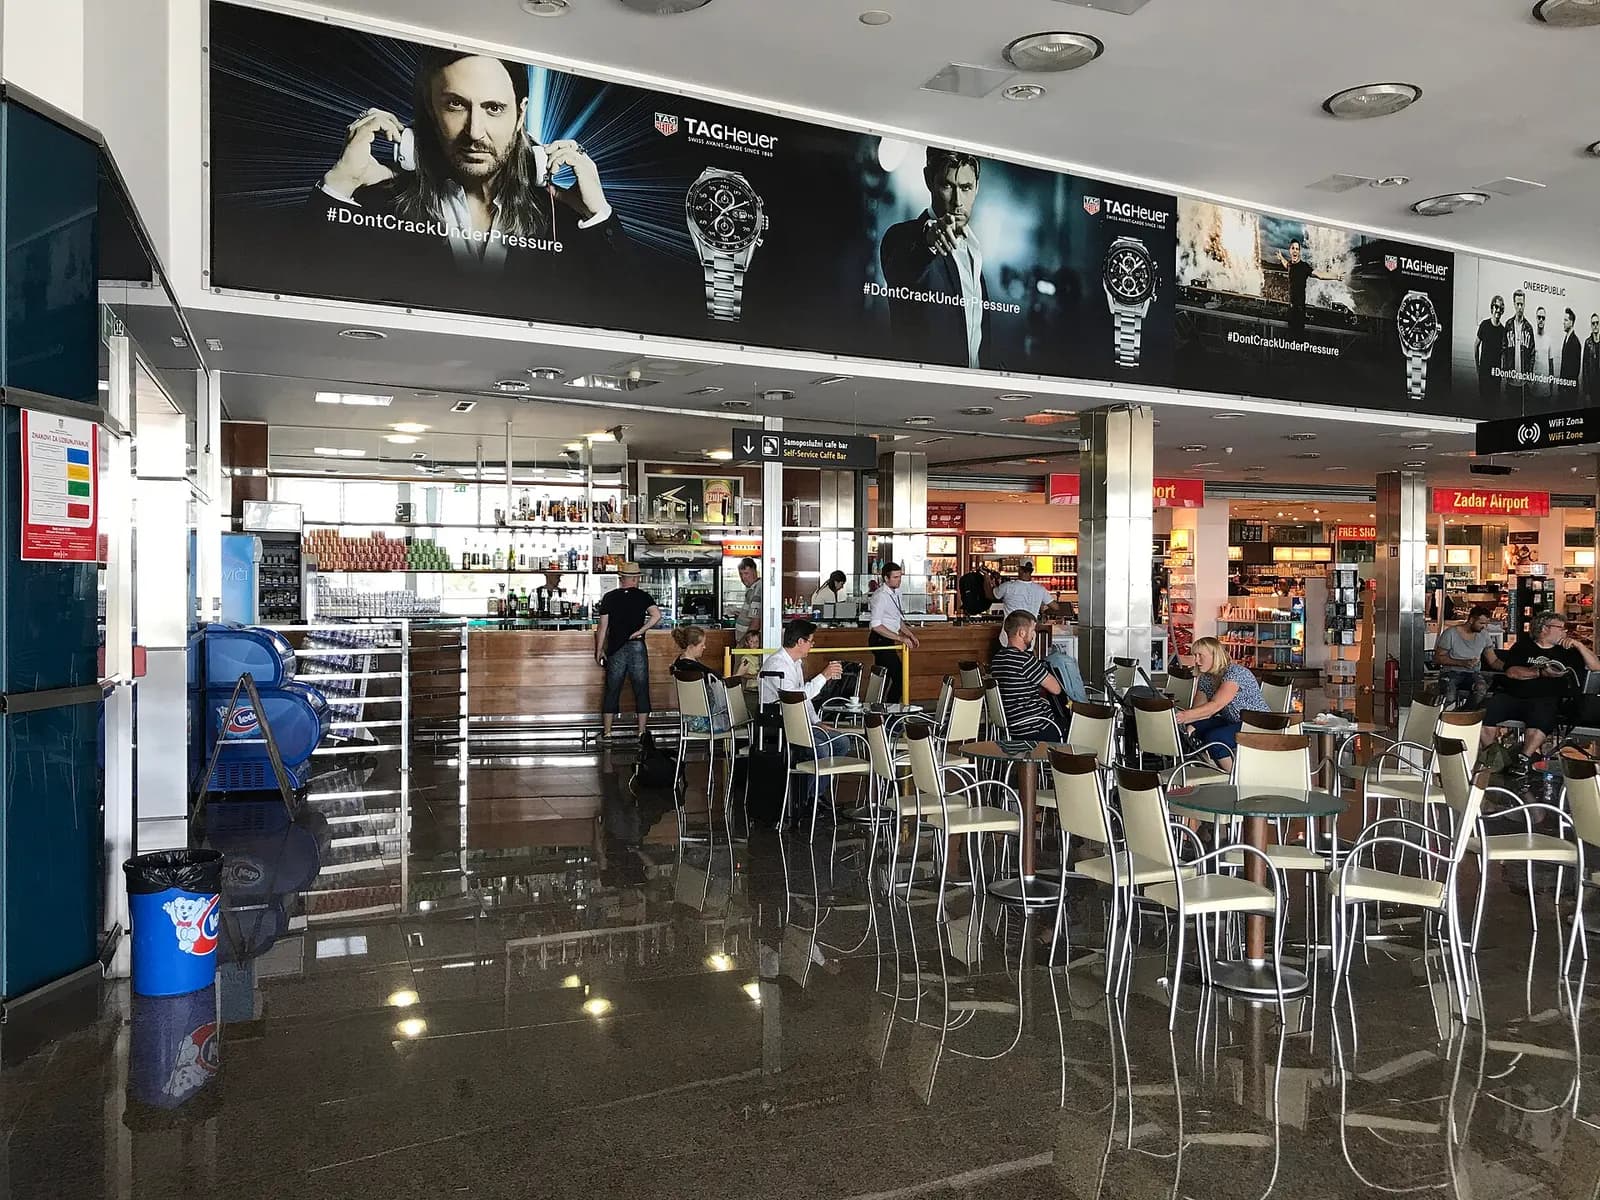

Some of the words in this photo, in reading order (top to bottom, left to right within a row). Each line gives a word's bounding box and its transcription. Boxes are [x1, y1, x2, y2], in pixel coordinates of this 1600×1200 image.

[657, 113, 676, 124] TAG
[327, 207, 563, 252] #DontCrackUnderPressure
[1523, 280, 1566, 297] ONEREPUBLIC
[863, 282, 1021, 314] #DontCrackUnderPressure
[1227, 331, 1340, 356] #DontCrackUnderPressure
[1491, 367, 1577, 387] #DontCrackUnderPressure
[1548, 418, 1565, 428] WiFi
[1566, 417, 1584, 426] Zona
[1548, 431, 1565, 441] WiFi
[1566, 431, 1584, 440] Zone
[838, 440, 848, 449] bar
[783, 448, 819, 459] Self-Service
[820, 450, 835, 459] Caffe
[837, 451, 847, 460] Bar
[1453, 492, 1487, 508] Zadar
[1489, 493, 1529, 512] Airport
[1338, 527, 1358, 537] FREE
[1359, 527, 1376, 537] SHO
